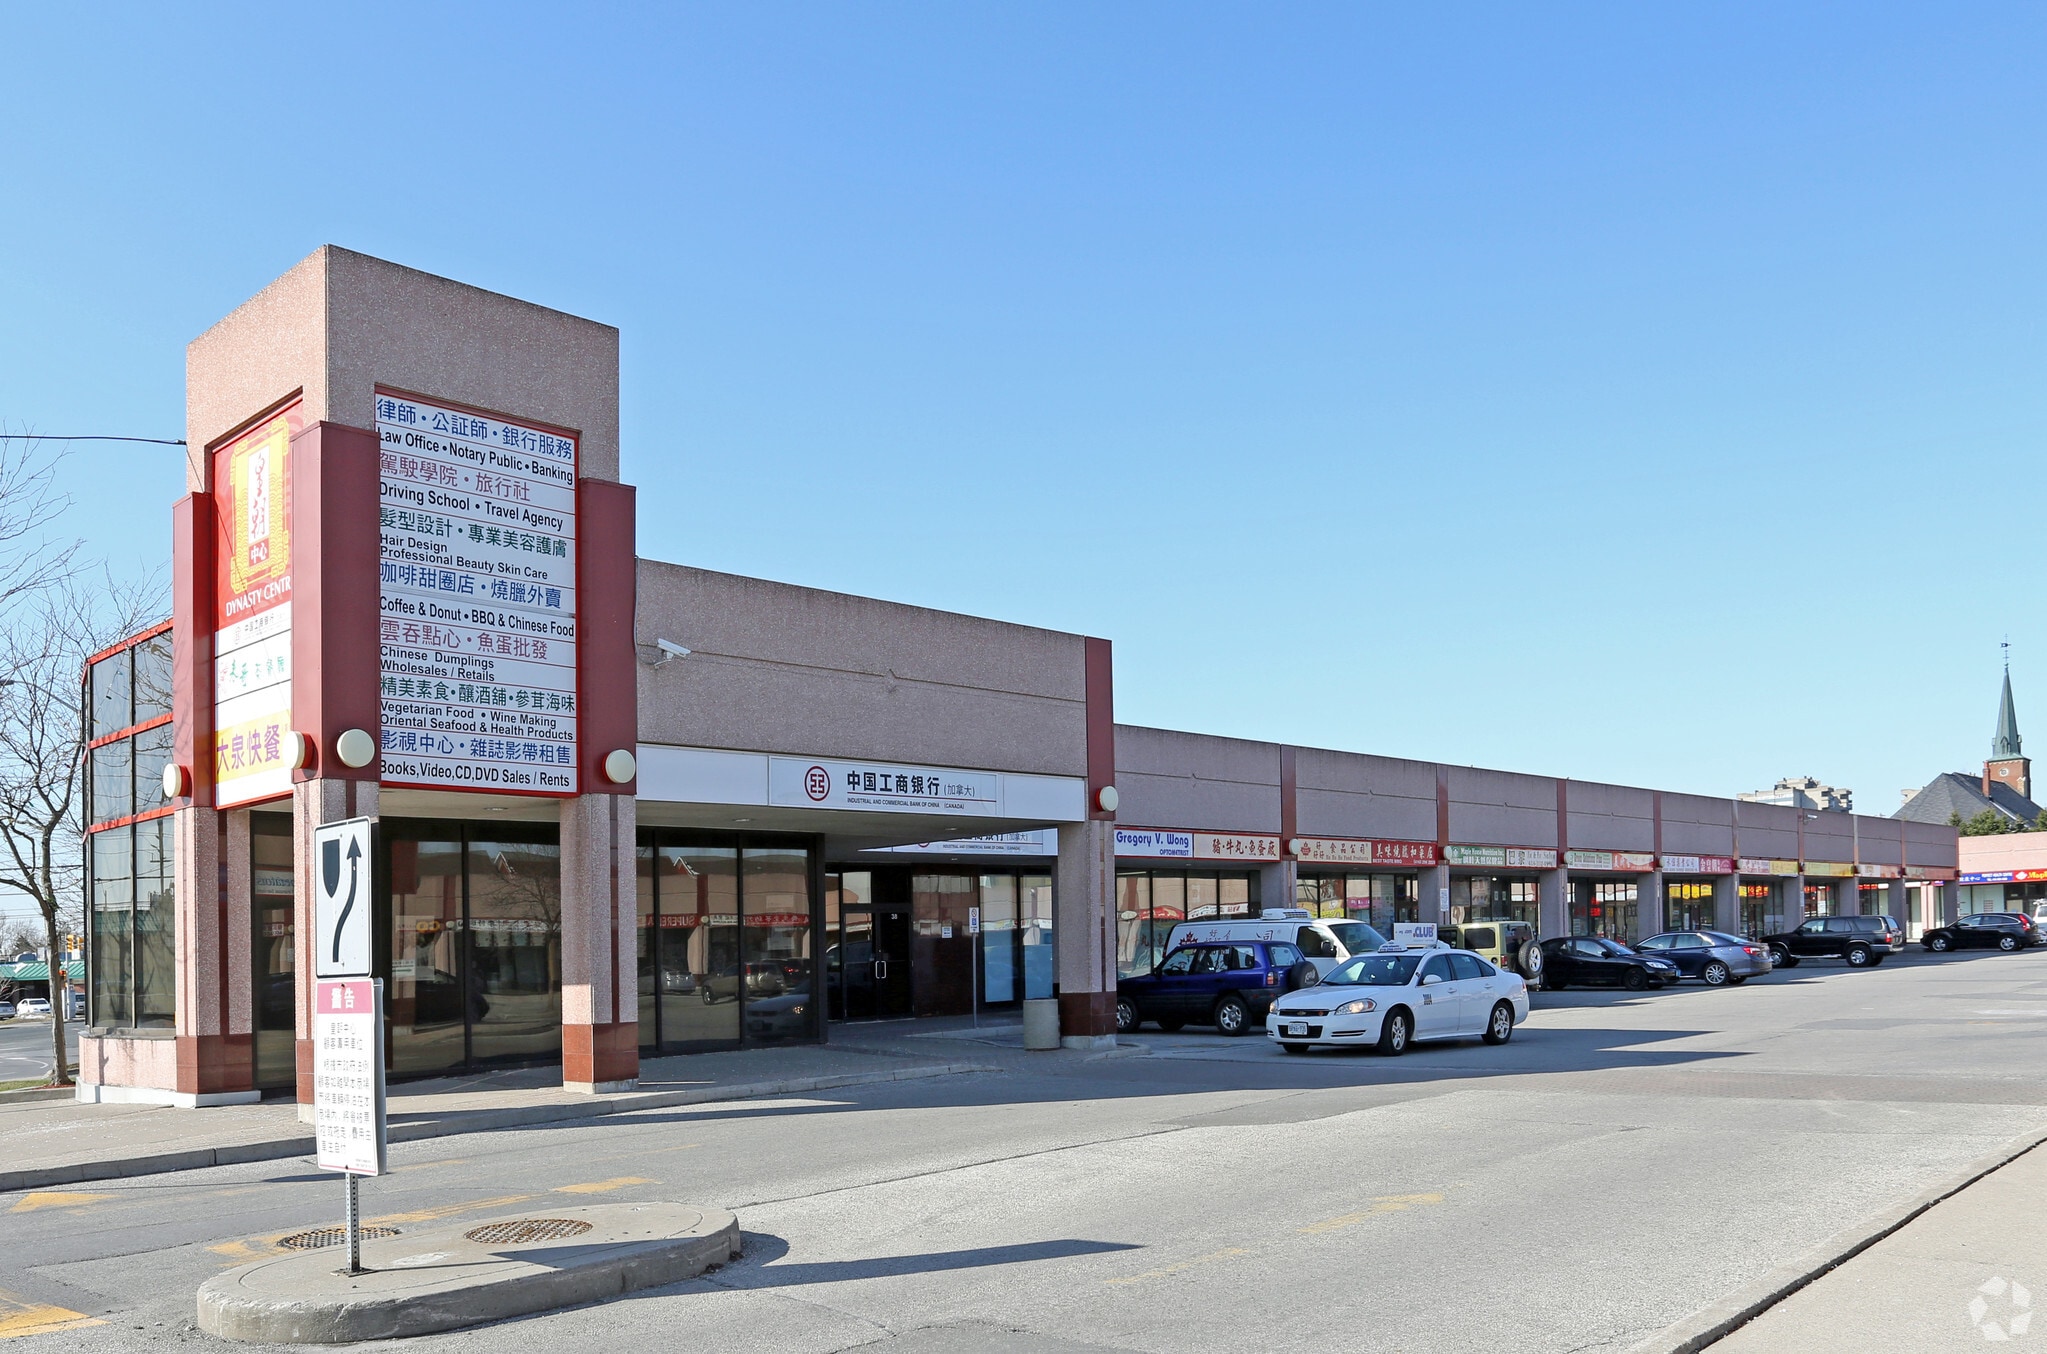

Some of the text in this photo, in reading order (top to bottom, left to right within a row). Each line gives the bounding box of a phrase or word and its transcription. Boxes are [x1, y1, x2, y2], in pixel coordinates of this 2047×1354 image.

[378, 427, 573, 485] Law Office Notary Public Banking
[380, 482, 563, 531] Driving School Travel Agency
[380, 534, 447, 553] Hair Design
[380, 548, 548, 580] Professional Beauty Skin Care
[226, 576, 291, 616] DYNASTY CENTR
[380, 596, 574, 637] Coffee & Donut BBQ & Chinese Food
[380, 646, 494, 669] Chinese Dumplings
[380, 660, 447, 677] Wholesales
[458, 670, 495, 682] Retails
[381, 701, 556, 729] Vegetarian Food Wine Making
[381, 714, 573, 740] Oriental Seafood & Health Products
[217, 724, 280, 772] 大泉快餐
[502, 766, 530, 785] Sales
[540, 770, 570, 787] Rents
[847, 770, 940, 796] 中国工商银行
[882, 799, 909, 807] COMMERCIAL
[1116, 831, 1189, 848] Gregory V. Wong
